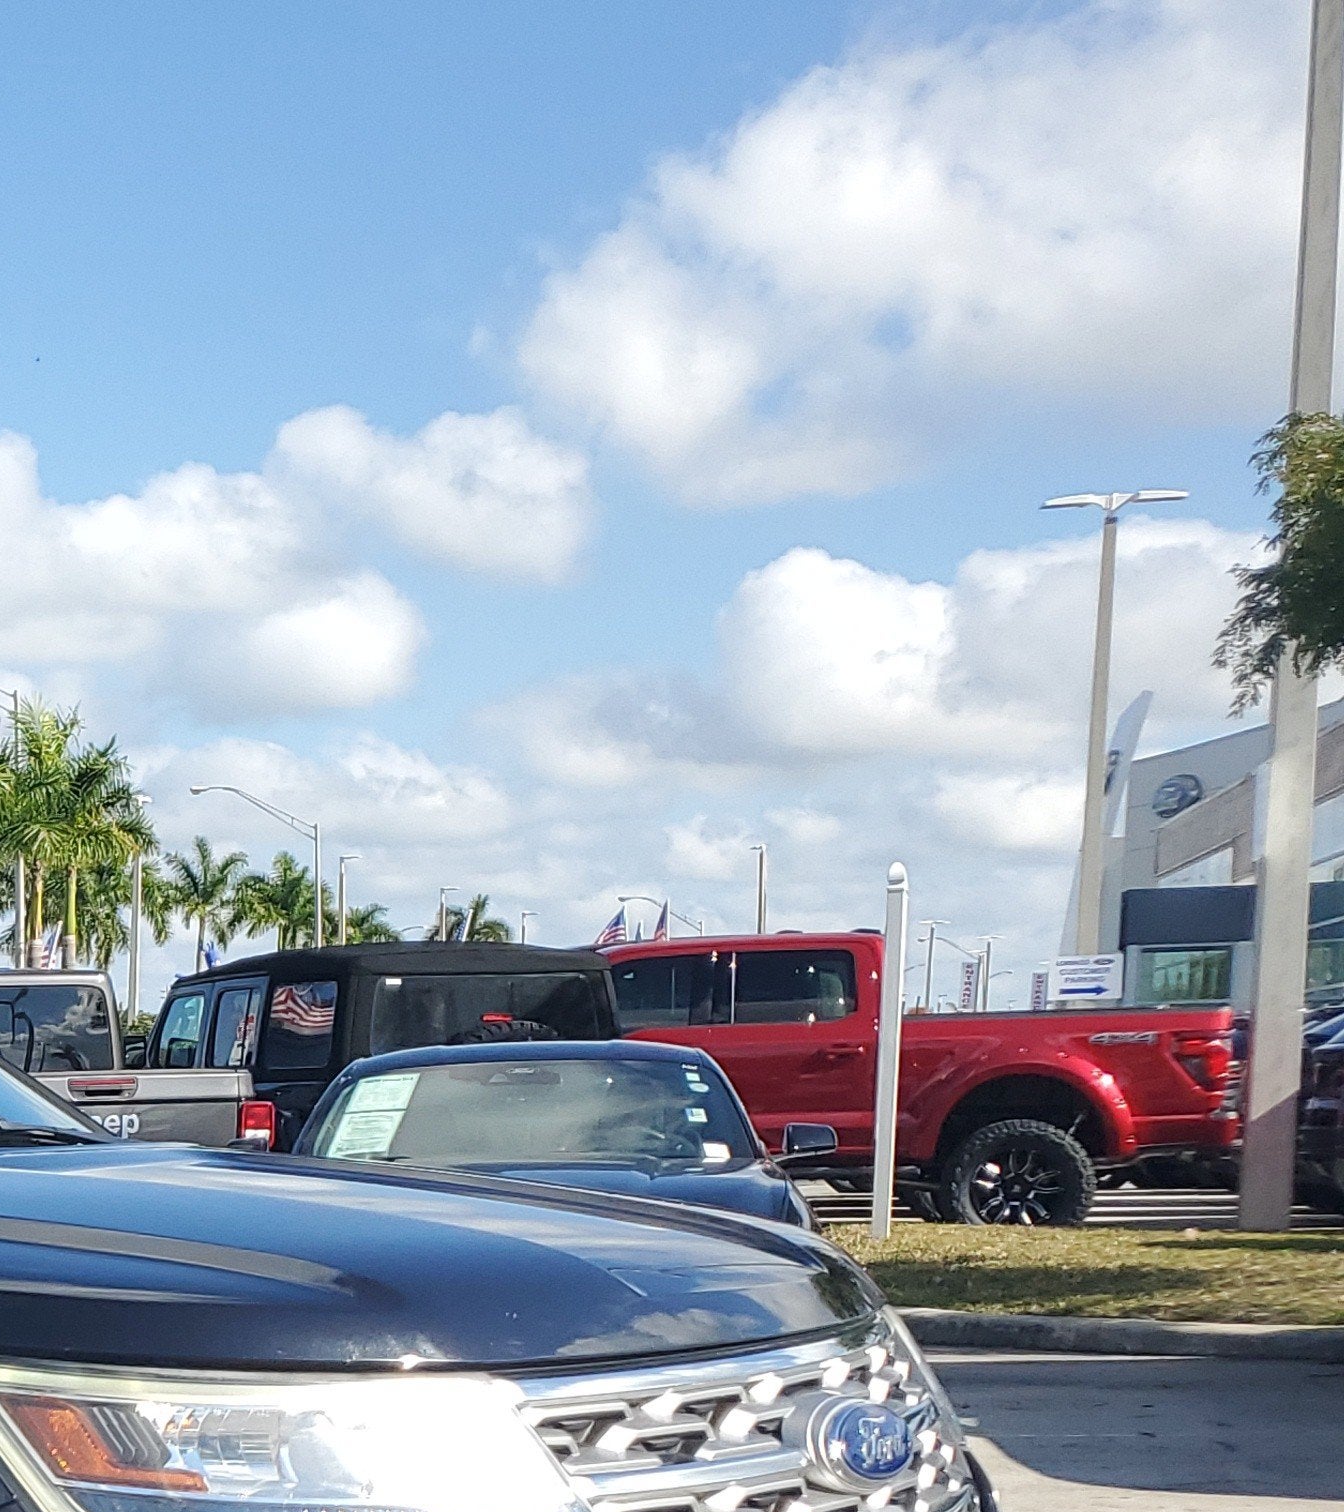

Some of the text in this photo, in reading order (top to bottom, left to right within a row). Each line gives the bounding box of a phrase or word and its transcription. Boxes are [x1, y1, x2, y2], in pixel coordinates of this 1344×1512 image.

[1033, 974, 1044, 1011] ENTRANC
[91, 1113, 140, 1140] ep
[858, 1415, 907, 1469] Ford
